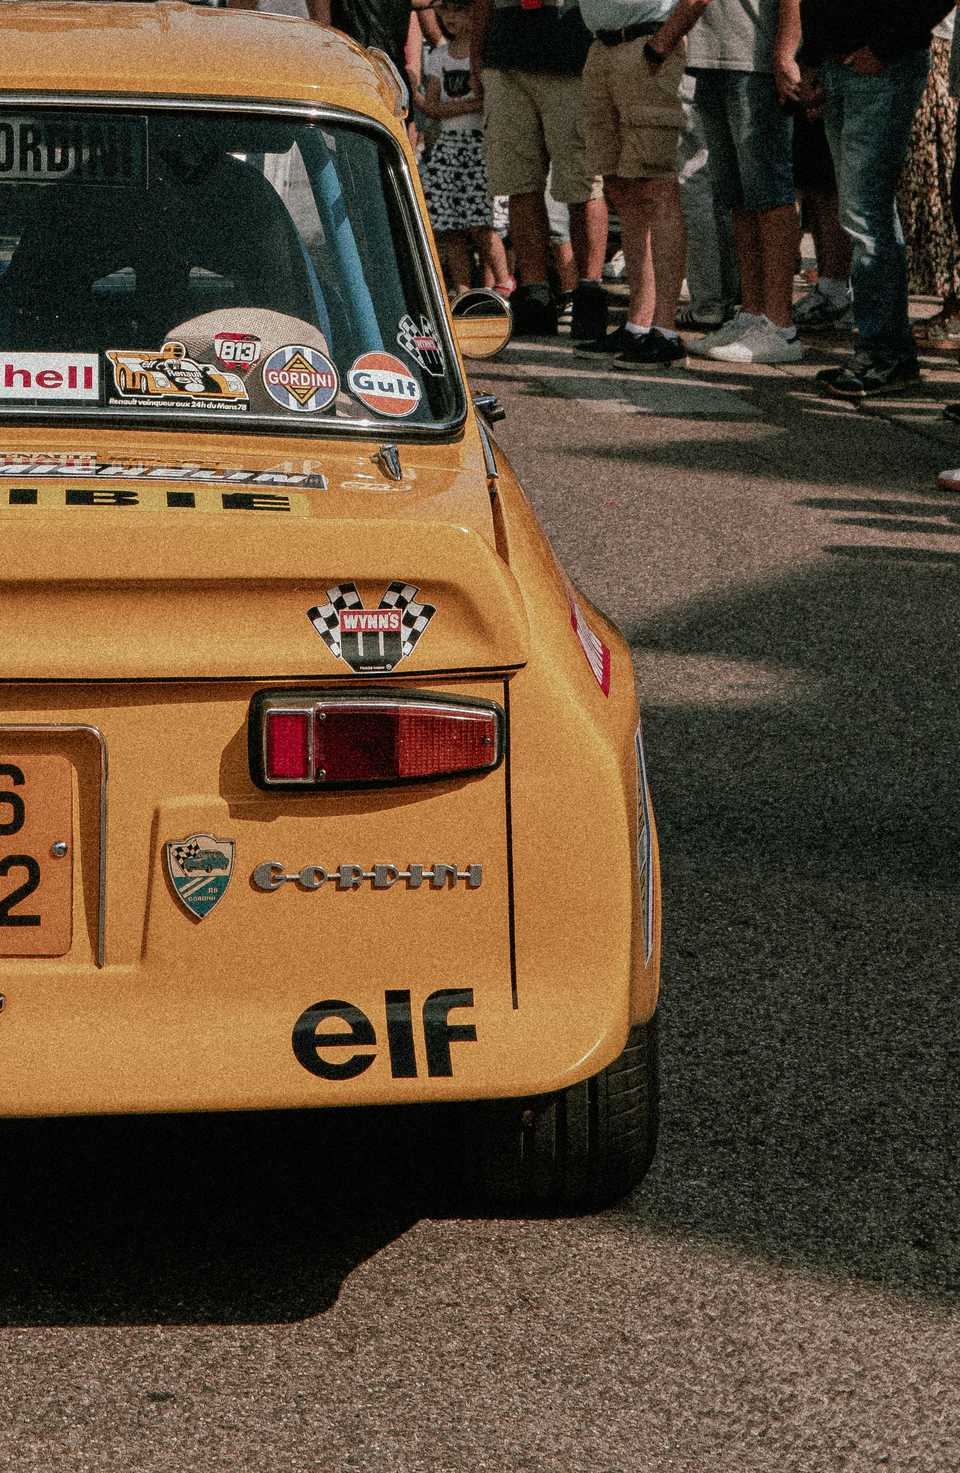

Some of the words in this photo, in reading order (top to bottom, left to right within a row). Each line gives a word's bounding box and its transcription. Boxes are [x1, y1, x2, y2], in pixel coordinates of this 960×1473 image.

[221, 341, 255, 362] 813
[268, 371, 333, 388] GORDINI
[352, 372, 417, 397] Gulf
[138, 399, 176, 408] vainqueur
[343, 612, 400, 630] WYNN'S
[292, 988, 477, 1081] elf
